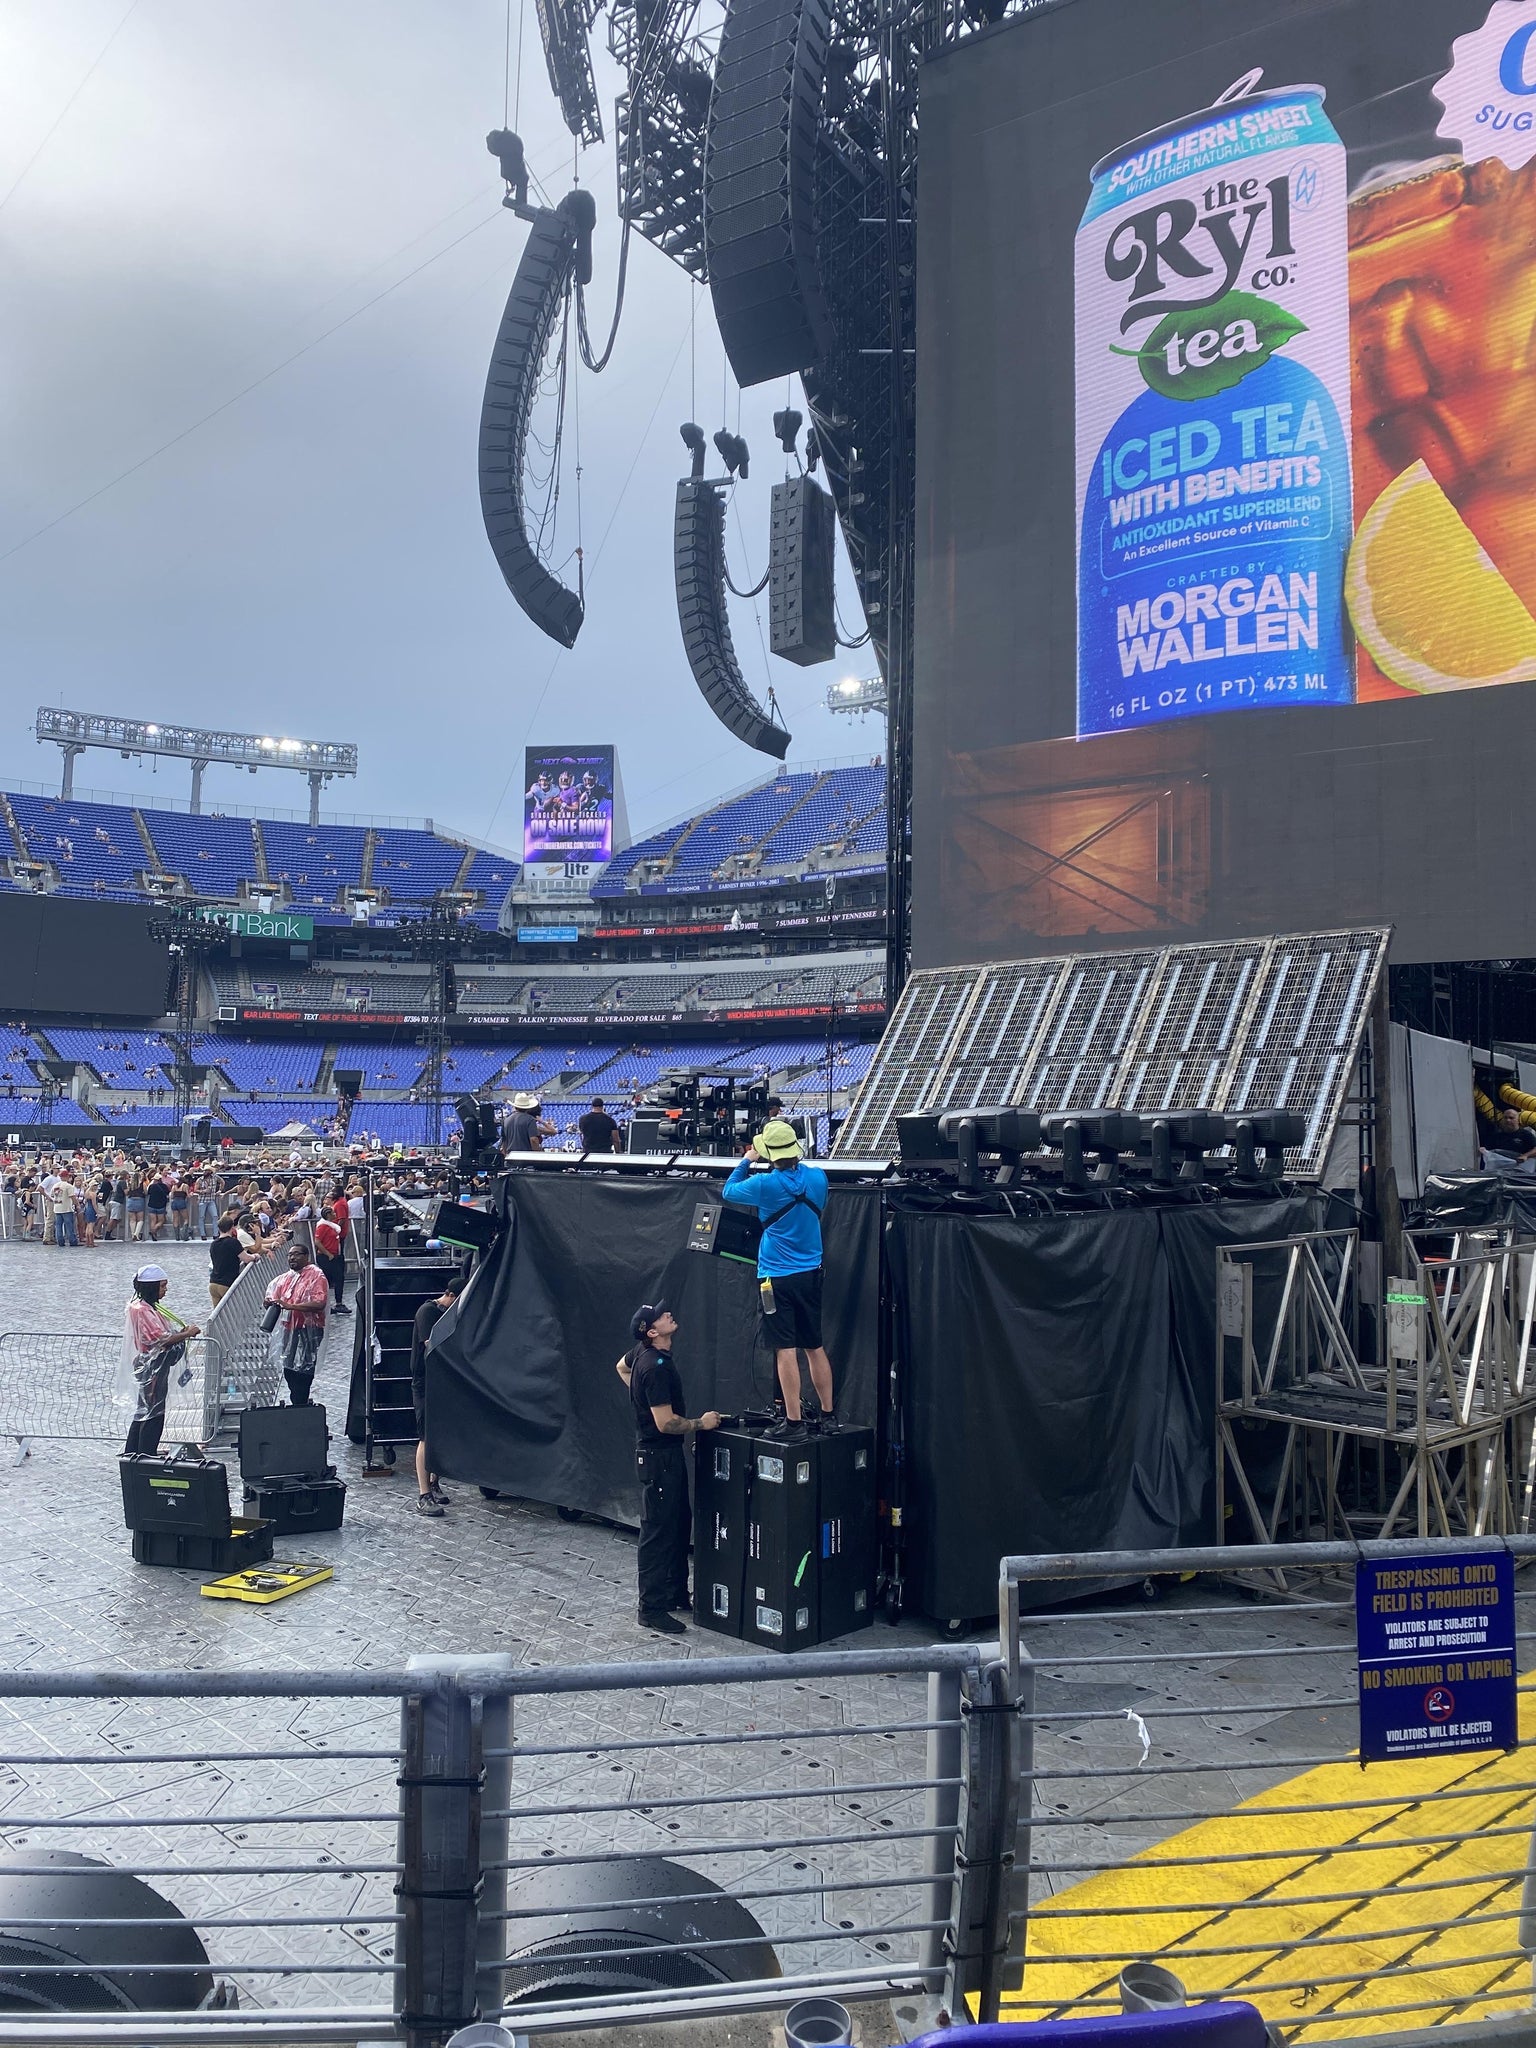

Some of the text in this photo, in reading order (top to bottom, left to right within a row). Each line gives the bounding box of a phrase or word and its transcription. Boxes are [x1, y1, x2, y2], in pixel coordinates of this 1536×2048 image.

[1107, 105, 1313, 193] SOUTHERN SWEET
[1126, 129, 1299, 196] WITH OTHER NATURAL FLAVORS
[1202, 175, 1259, 211] the
[1104, 175, 1296, 335] Ryl
[1162, 318, 1264, 376] tea
[1102, 399, 1329, 499] ICED TEA
[1109, 455, 1321, 528] WITH BENEFITS
[1112, 496, 1321, 552] ANTIOXIDANT SUPERBLEND
[1123, 516, 1310, 562] An Excellent Source of Vitamin C
[1167, 561, 1266, 588] CRAFTED BY
[1117, 572, 1318, 642] MORGAN
[1118, 609, 1319, 678] WALLEN
[1109, 672, 1328, 719] 16 FL OZ (1 PT) 473 ML
[530, 819, 606, 837] ON SALE NOW
[563, 862, 590, 879] Lite
[247, 914, 300, 938] Bank
[643, 927, 655, 935] TEXT
[745, 922, 759, 930] VOTE!
[780, 918, 809, 927] SUMMERS
[841, 910, 877, 920] TENNESSEE
[259, 1011, 271, 1019] LIVE
[272, 1011, 301, 1019] TONIGHT?
[359, 1014, 376, 1022] SONG
[727, 1011, 743, 1019] WHICH
[743, 1011, 757, 1019] SONG
[757, 1010, 764, 1018] DO
[764, 1010, 774, 1018] YOU
[775, 1009, 788, 1017] WANT
[789, 1008, 796, 1016] TO
[795, 1008, 808, 1016] HEAR
[11, 1134, 17, 1143] L
[106, 1136, 113, 1147] H
[313, 1142, 322, 1153] C
[373, 1139, 379, 1149] J
[567, 1141, 574, 1149] K
[1375, 1565, 1496, 1590] TRESPASSING ONTO
[1373, 1587, 1499, 1613] FIELD IS PROHIBITED
[1385, 1616, 1489, 1635] VIOLATORS ARE SUBJECT TO
[1388, 1631, 1487, 1650] ARREST AND PROSECUTION
[1363, 1659, 1512, 1689] NO SMOKING OR VAPING
[1387, 1721, 1492, 1742] VIOLATORS WILL BE EJECTED
